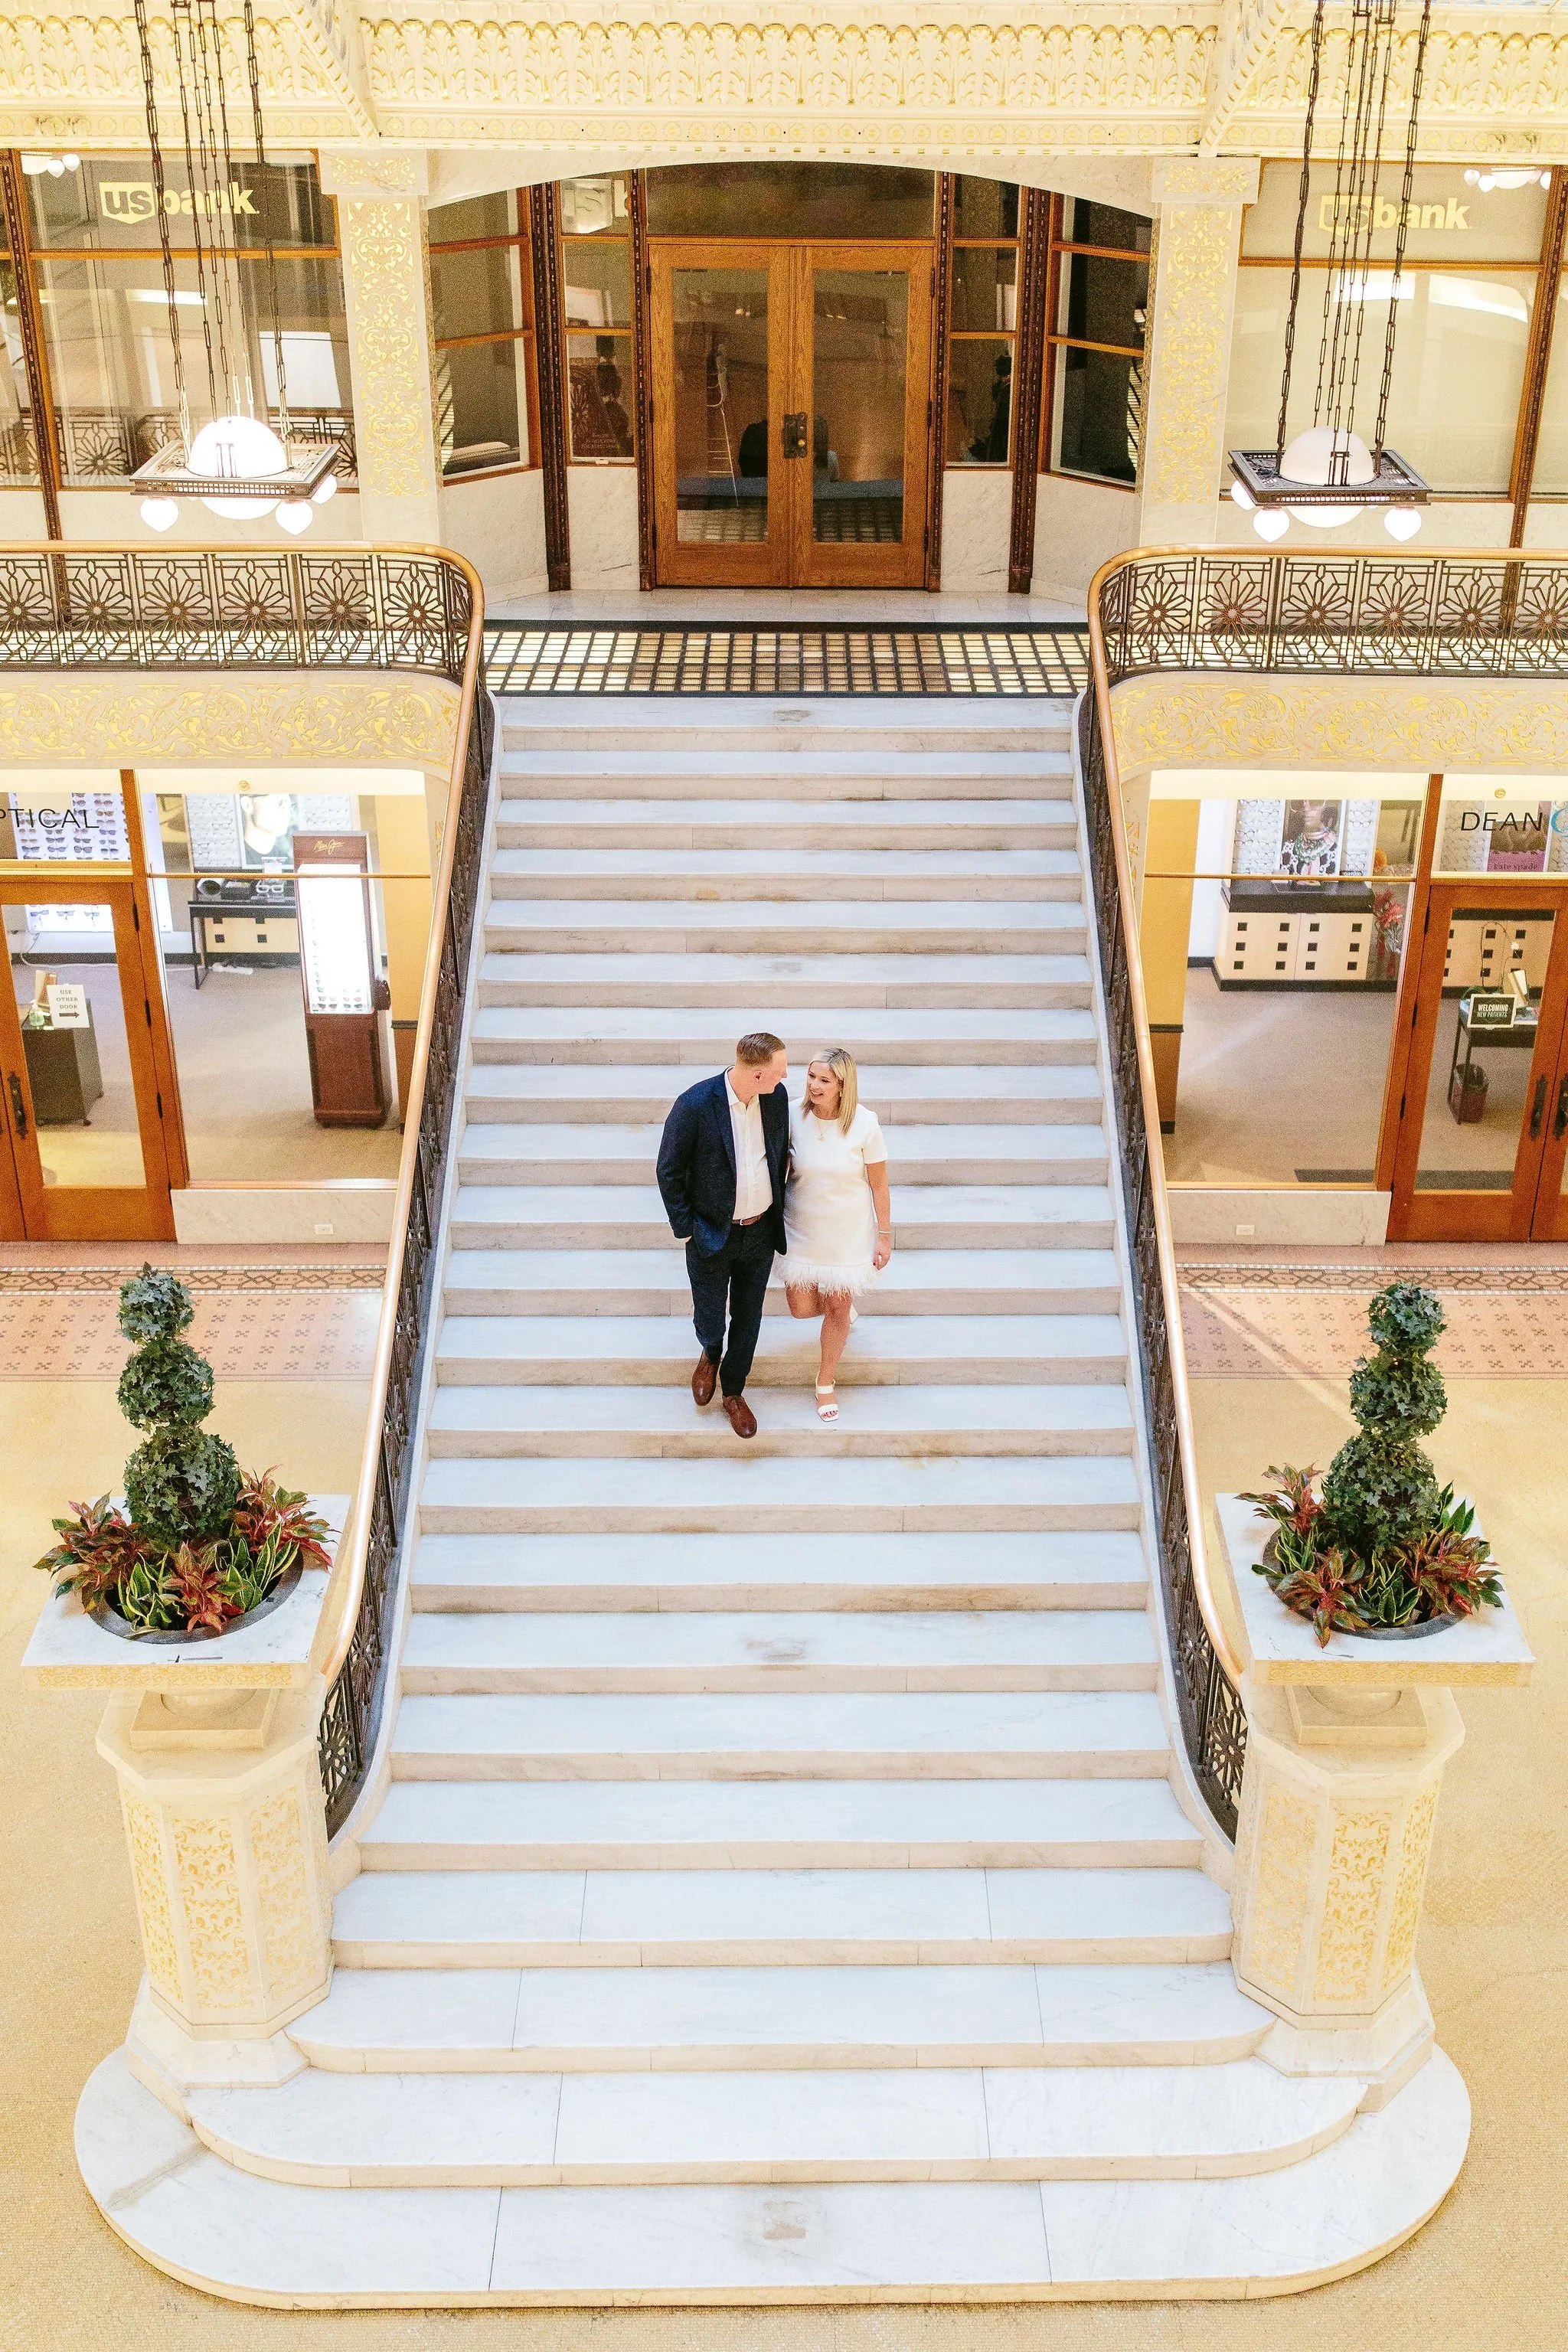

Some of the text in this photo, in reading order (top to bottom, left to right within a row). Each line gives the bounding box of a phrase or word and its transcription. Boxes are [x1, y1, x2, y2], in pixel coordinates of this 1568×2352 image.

[1373, 195, 1471, 230] bank
[1461, 812, 1543, 831] DEAN
[1478, 1004, 1509, 1012] WELCOMING
